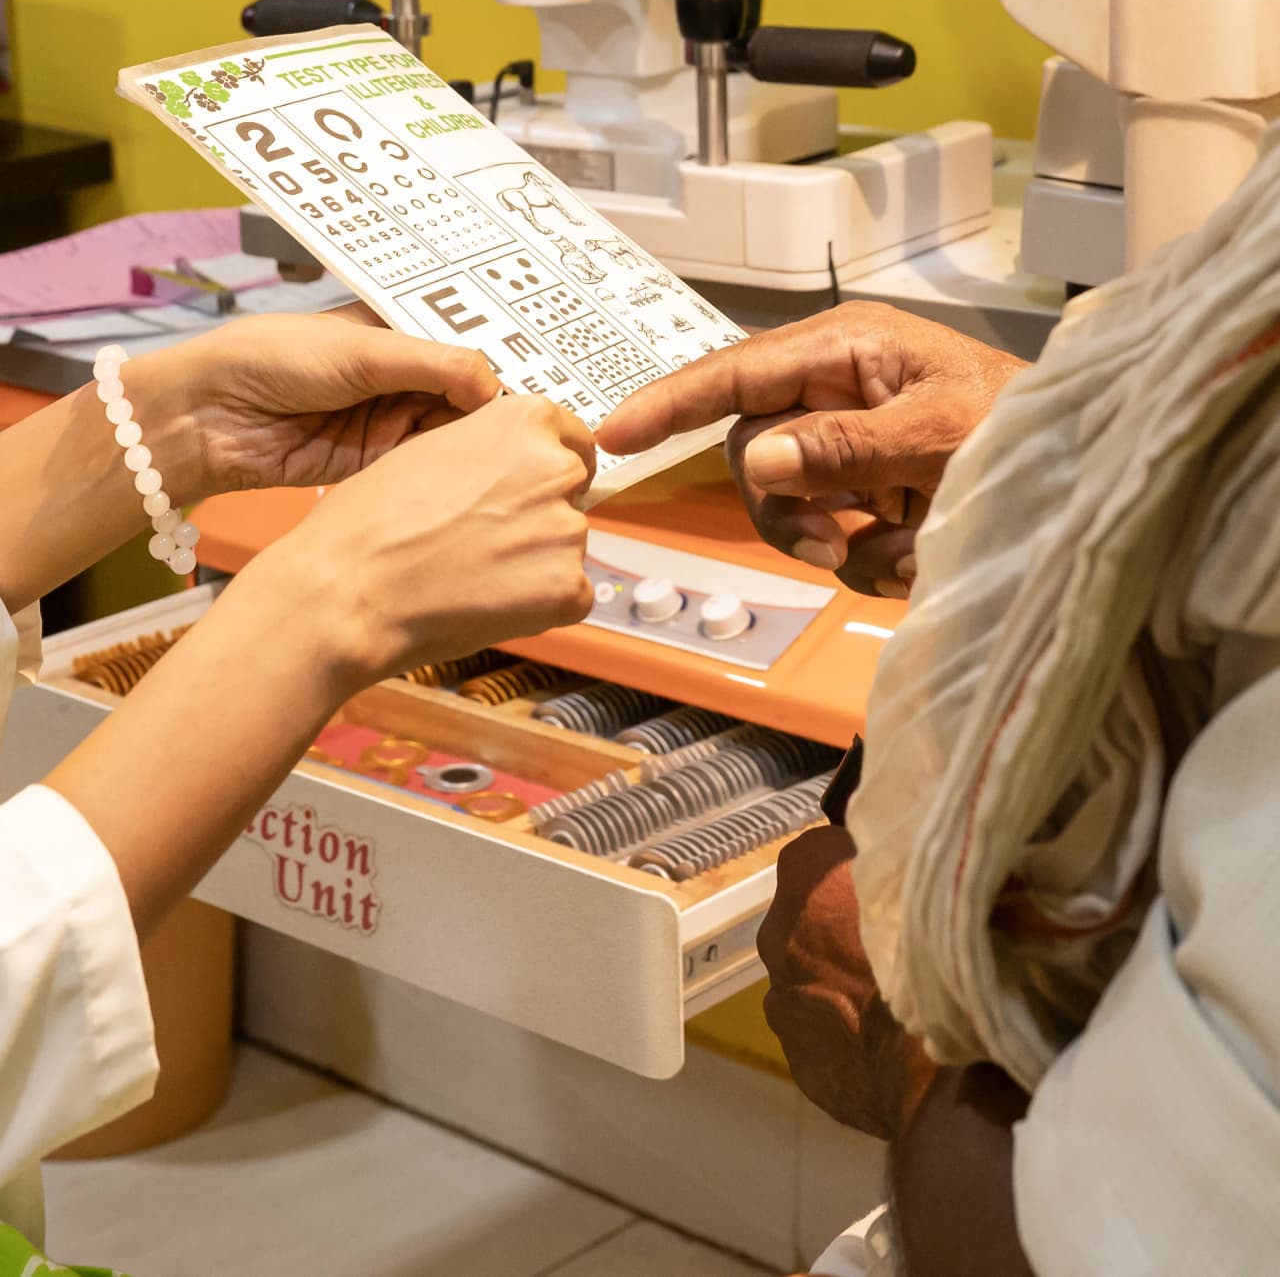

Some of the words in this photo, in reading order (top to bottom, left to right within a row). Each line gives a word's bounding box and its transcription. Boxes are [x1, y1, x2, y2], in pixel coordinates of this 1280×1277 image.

[276, 66, 333, 89] TEST
[328, 54, 388, 75] TYPE
[379, 52, 421, 69] FOR
[345, 73, 447, 100] ILLITERATES
[413, 95, 436, 111] &
[236, 122, 295, 162] 2
[405, 114, 487, 139] CHILDREN
[421, 286, 489, 334] E
[246, 810, 370, 876] ction
[276, 853, 377, 930] Unit
